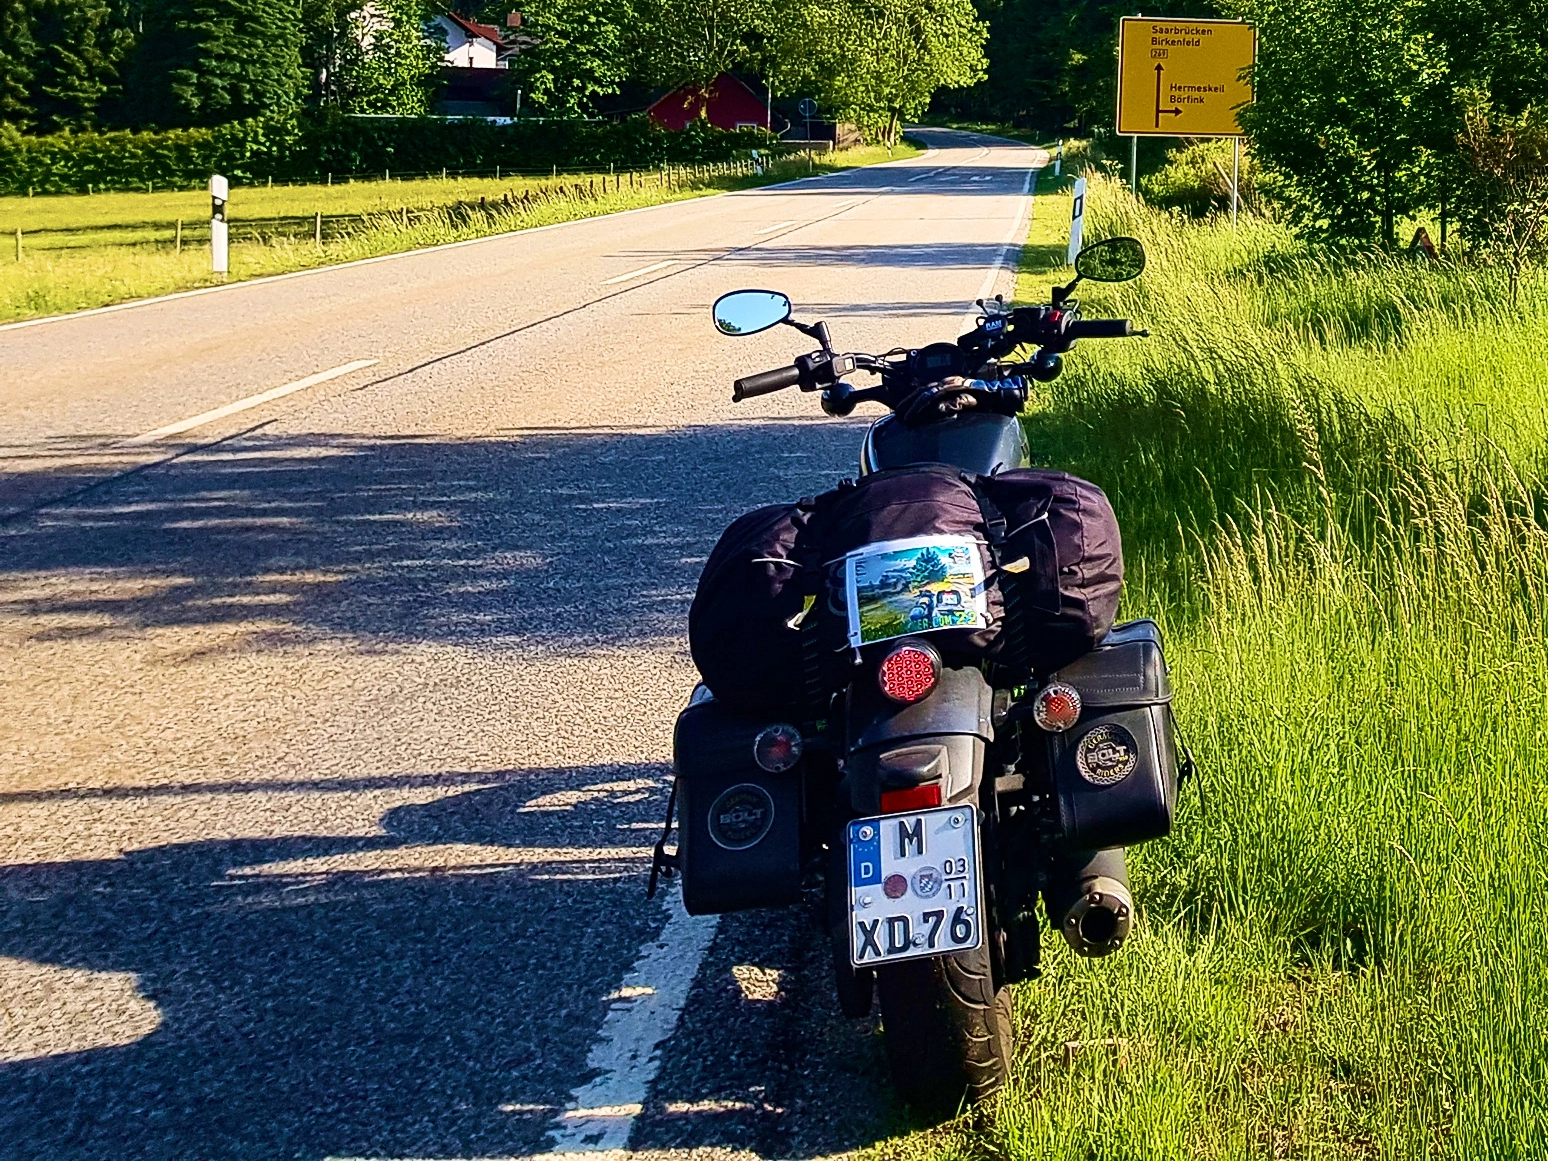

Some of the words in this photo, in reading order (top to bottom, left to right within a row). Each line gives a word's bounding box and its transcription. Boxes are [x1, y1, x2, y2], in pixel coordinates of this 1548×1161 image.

[1151, 25, 1213, 35] Saarbrücken
[1151, 36, 1201, 46] Birkenfeld
[1170, 83, 1225, 93] Hermeskeil
[1170, 94, 1205, 104] Börfink
[899, 817, 925, 858] M
[860, 861, 874, 880] D
[943, 857, 968, 875] 03
[946, 882, 968, 900] 11
[857, 914, 912, 960] XD
[922, 905, 973, 949] 76
